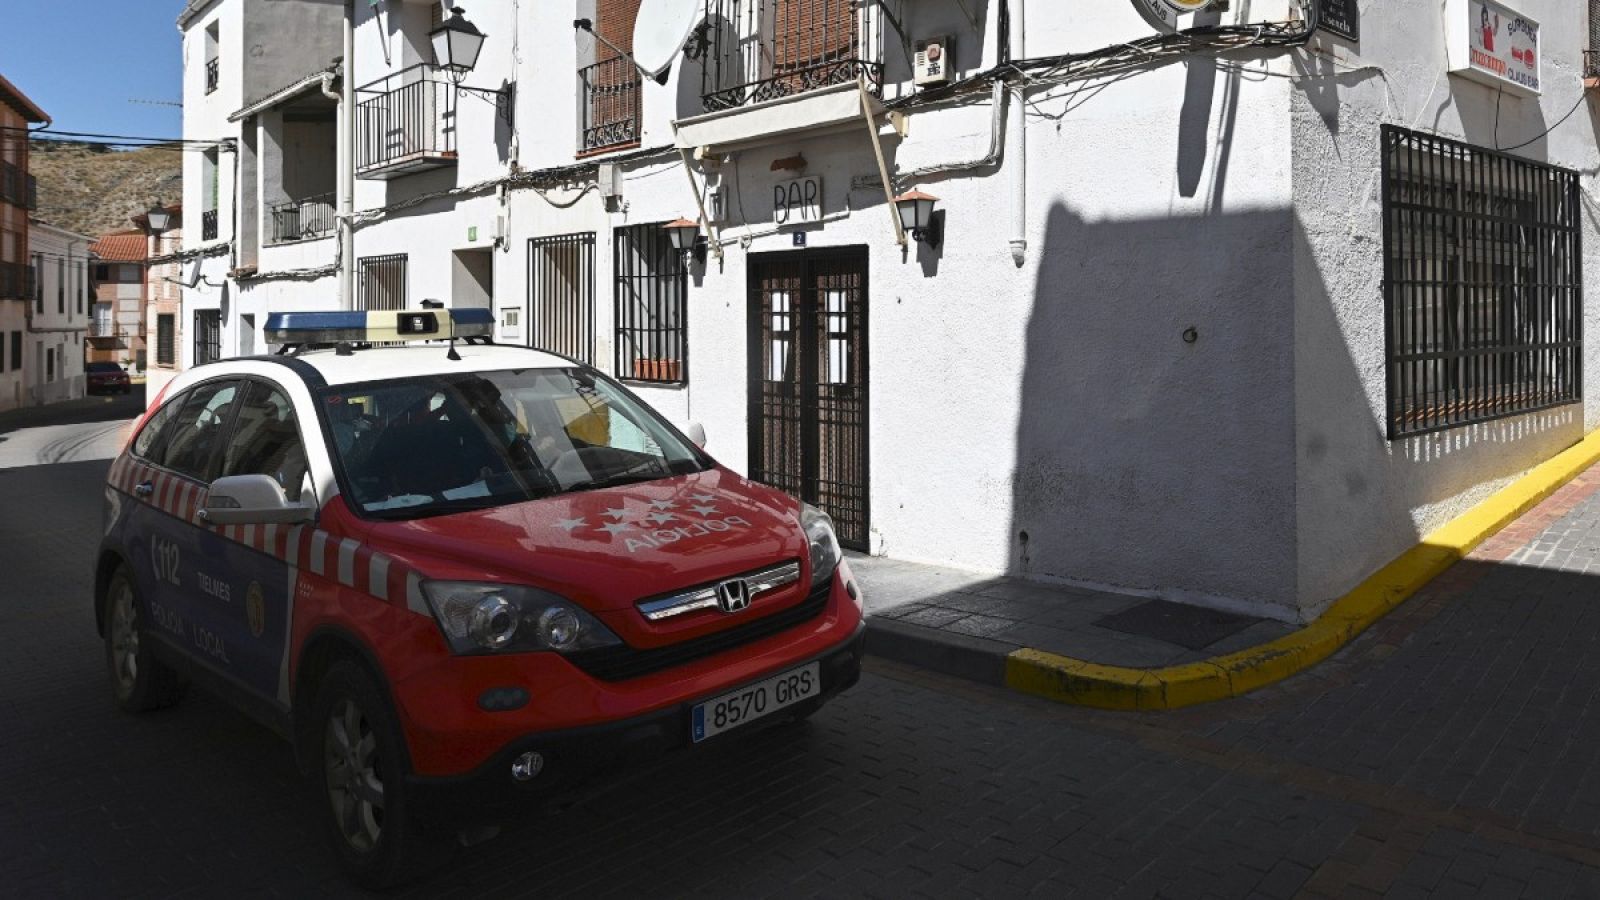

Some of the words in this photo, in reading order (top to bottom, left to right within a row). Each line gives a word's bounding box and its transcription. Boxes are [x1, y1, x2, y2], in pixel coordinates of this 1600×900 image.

[1148, 0, 1167, 20] AUS
[774, 179, 817, 225] BAR
[158, 539, 181, 586] 112
[197, 571, 231, 603] TIELMES
[192, 623, 230, 664] LOCAL
[713, 687, 767, 728] 8570
[775, 670, 812, 703] GRS
